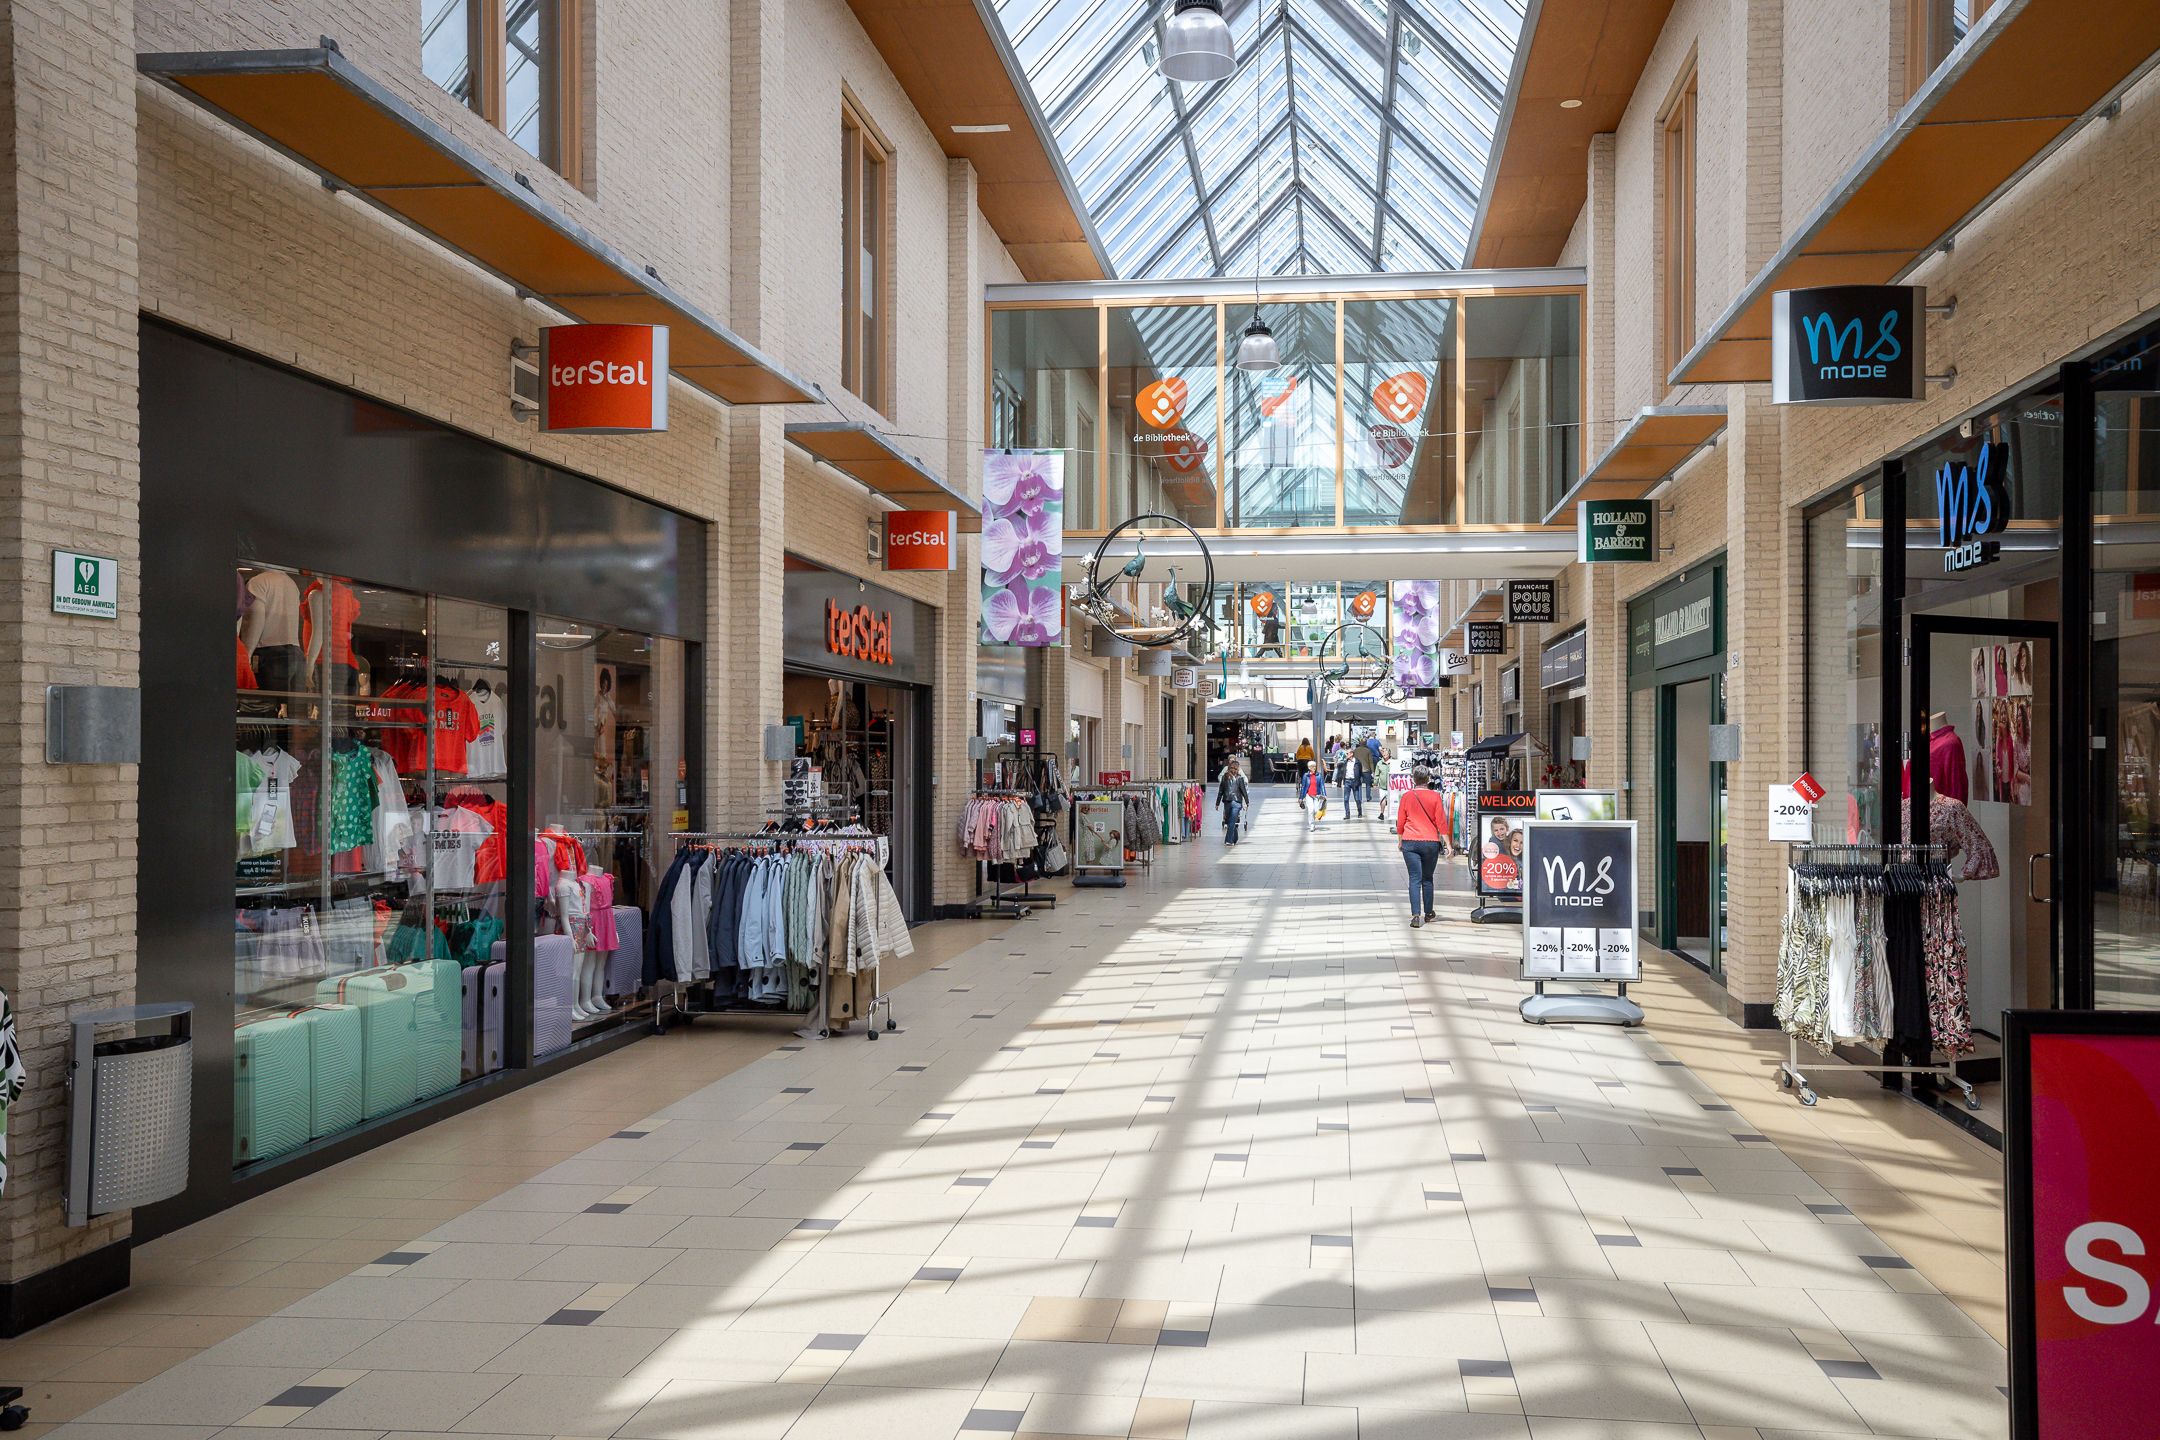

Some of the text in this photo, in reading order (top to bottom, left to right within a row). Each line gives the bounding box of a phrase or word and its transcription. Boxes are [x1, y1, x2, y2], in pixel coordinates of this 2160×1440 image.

[551, 360, 648, 387] terStal
[1820, 365, 1887, 380] mode
[1133, 433, 1191, 442] de Bibliotheek
[1370, 429, 1381, 438] de
[1593, 512, 1647, 526] HOLLAND
[1615, 524, 1627, 537] &
[889, 531, 946, 546] terStal
[1594, 537, 1646, 550] BARRETT
[1944, 540, 1982, 573] mode
[76, 583, 97, 594] AED
[1512, 592, 1551, 603] POUR
[1512, 603, 1551, 614] VOUS
[829, 597, 893, 666] terStal
[1471, 631, 1500, 639] POUR
[1471, 639, 1500, 648] VOUS
[1447, 653, 1468, 665] Etos
[1799, 779, 1818, 799] PROMO
[1480, 795, 1536, 807] WELKOM
[1773, 805, 1809, 816] -20%
[1554, 896, 1604, 907] mode
[1532, 944, 1558, 953] -20%
[1566, 943, 1594, 952] -20%
[1602, 944, 1630, 953] -20%
[2063, 1221, 2160, 1325] S
